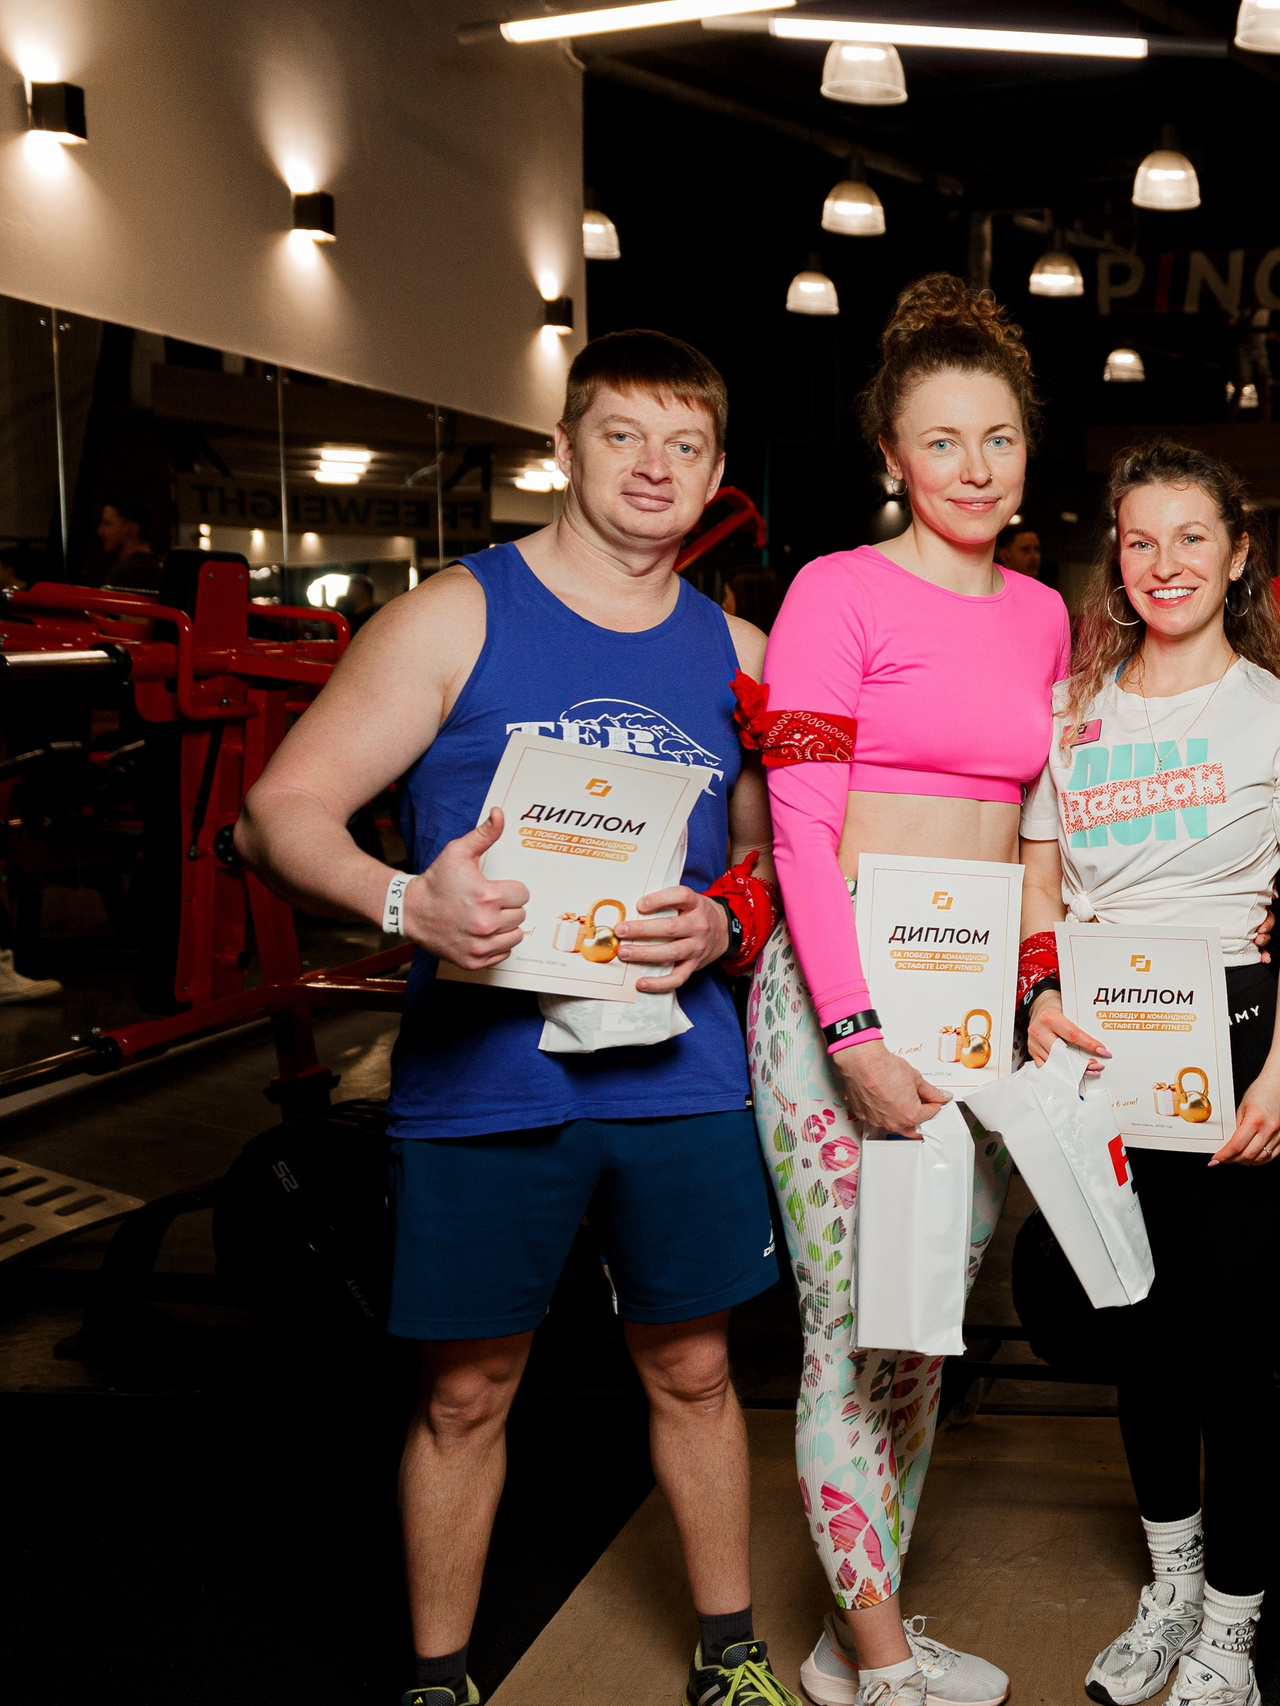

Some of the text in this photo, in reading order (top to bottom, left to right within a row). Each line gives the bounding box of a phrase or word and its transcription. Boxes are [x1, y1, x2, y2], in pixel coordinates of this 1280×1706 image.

[520, 803, 647, 836] ДИПЛОМ
[521, 828, 533, 837] ЗА
[534, 830, 572, 843] ПОБЕДУ
[580, 837, 636, 852] КОМАНДНОЙ
[523, 840, 626, 861] ЭСТАФЕТЕ LOFT FITNESS
[887, 925, 990, 945] ДИПЛОМ
[896, 962, 935, 970] ЭСТАФЕТЕ
[903, 952, 934, 960] ПОБЕДУ
[941, 952, 987, 962] КОМАНДНОЙ
[1092, 987, 1194, 1006] ДИПЛОМ
[1108, 1012, 1139, 1021] ПОБЕДУ
[1146, 1013, 1195, 1022] КОМАНДНОЙ
[1229, 1004, 1260, 1026] MY
[1103, 1022, 1141, 1030] ЭСТАФЕТЕ
